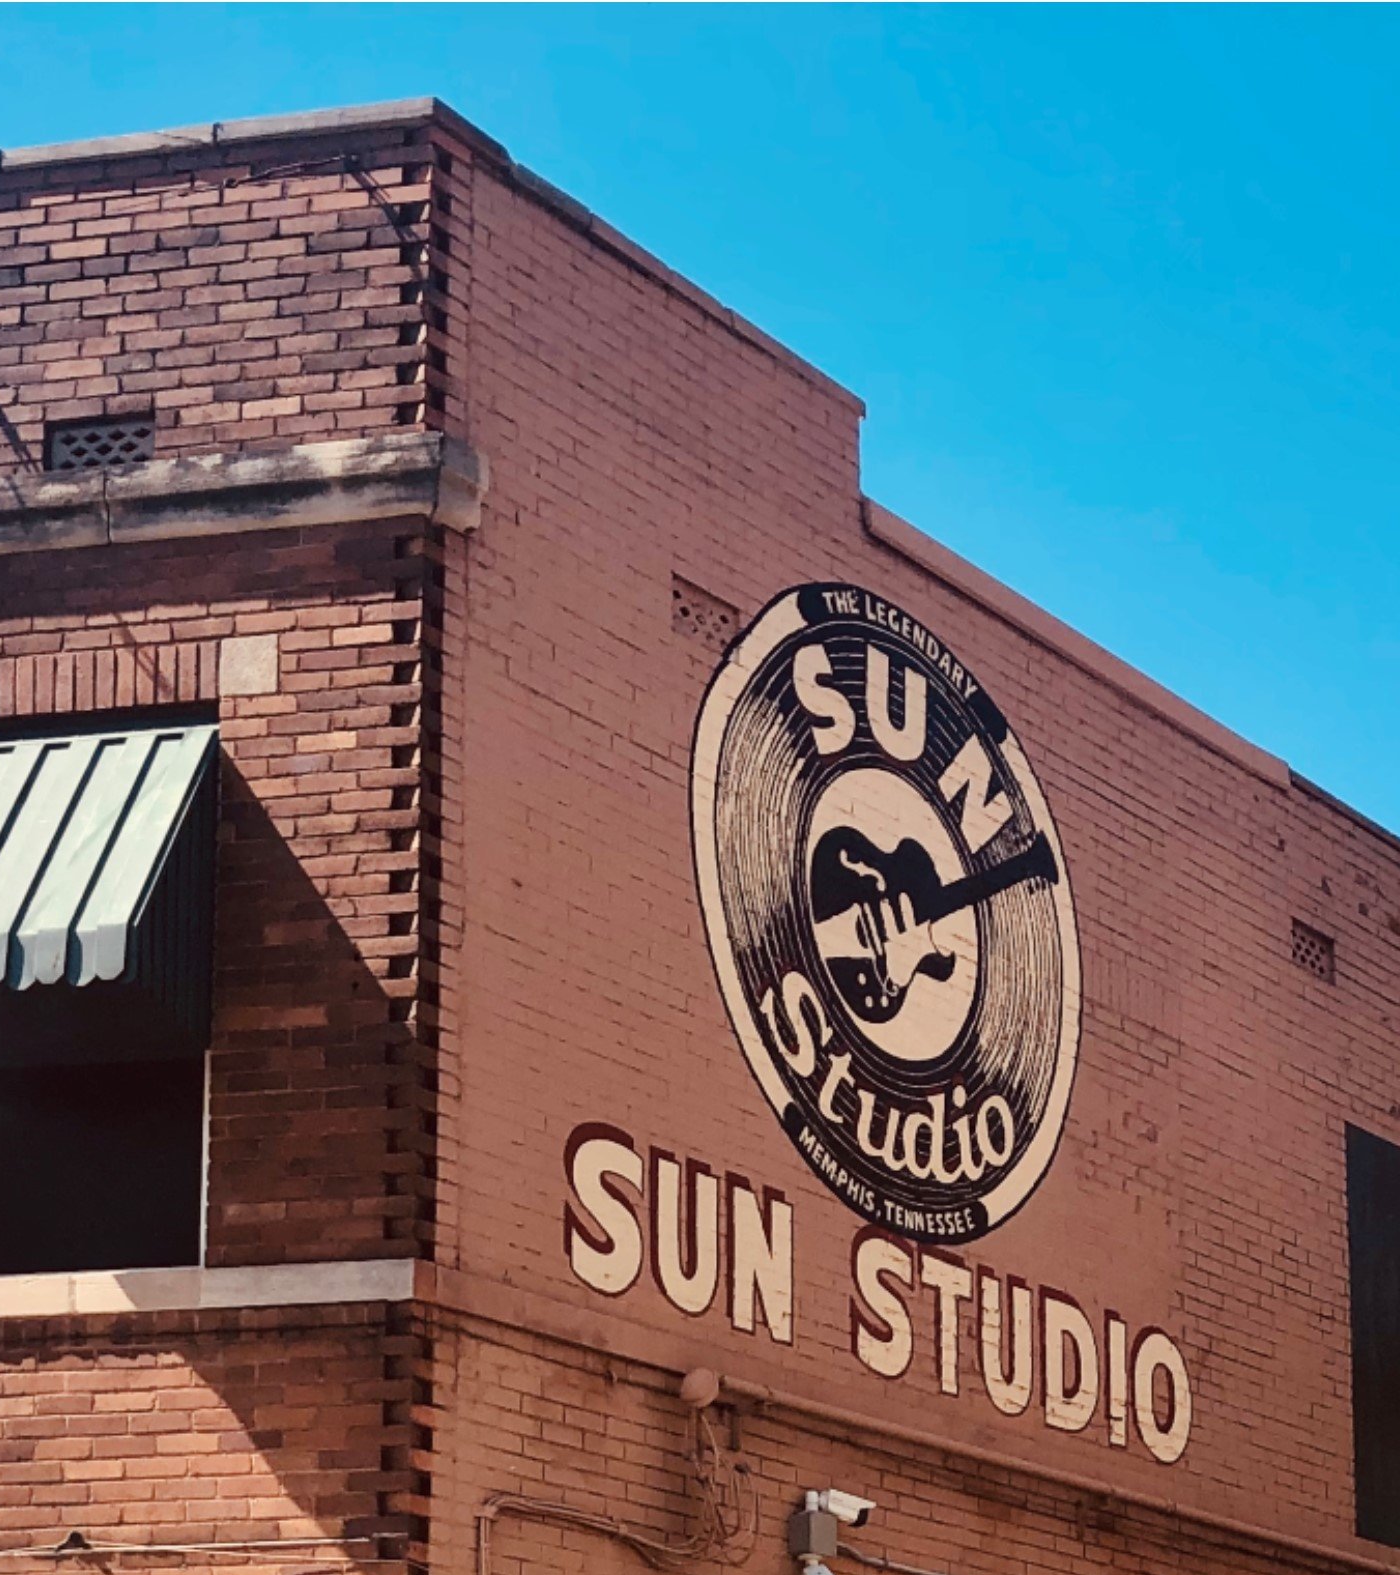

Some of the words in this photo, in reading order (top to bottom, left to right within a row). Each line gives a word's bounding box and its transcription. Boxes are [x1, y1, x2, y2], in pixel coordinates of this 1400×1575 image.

[792, 642, 1013, 853] SUN
[822, 588, 860, 614] THE
[865, 594, 978, 699] LEGENDARY
[760, 970, 1015, 1184] Studio
[565, 1124, 793, 1346] SUN
[851, 1230, 1193, 1465] STUDIO
[883, 1200, 976, 1236] TENNESSEE
